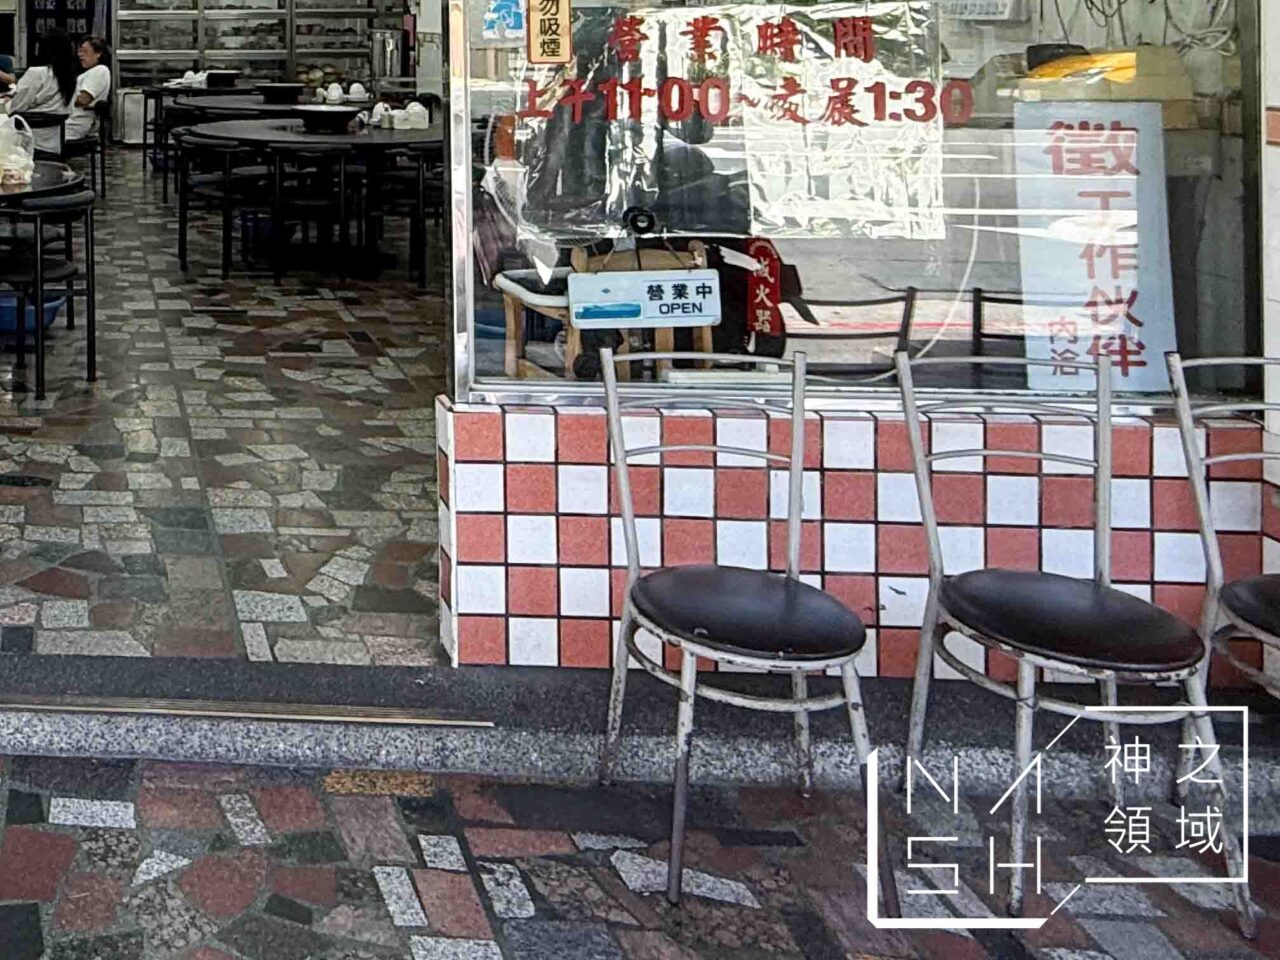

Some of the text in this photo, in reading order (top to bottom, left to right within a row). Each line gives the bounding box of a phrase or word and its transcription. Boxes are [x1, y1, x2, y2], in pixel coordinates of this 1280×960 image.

[608, 15, 876, 63] 營業時間
[646, 282, 714, 301] 營業中
[658, 301, 704, 315] OPEN
